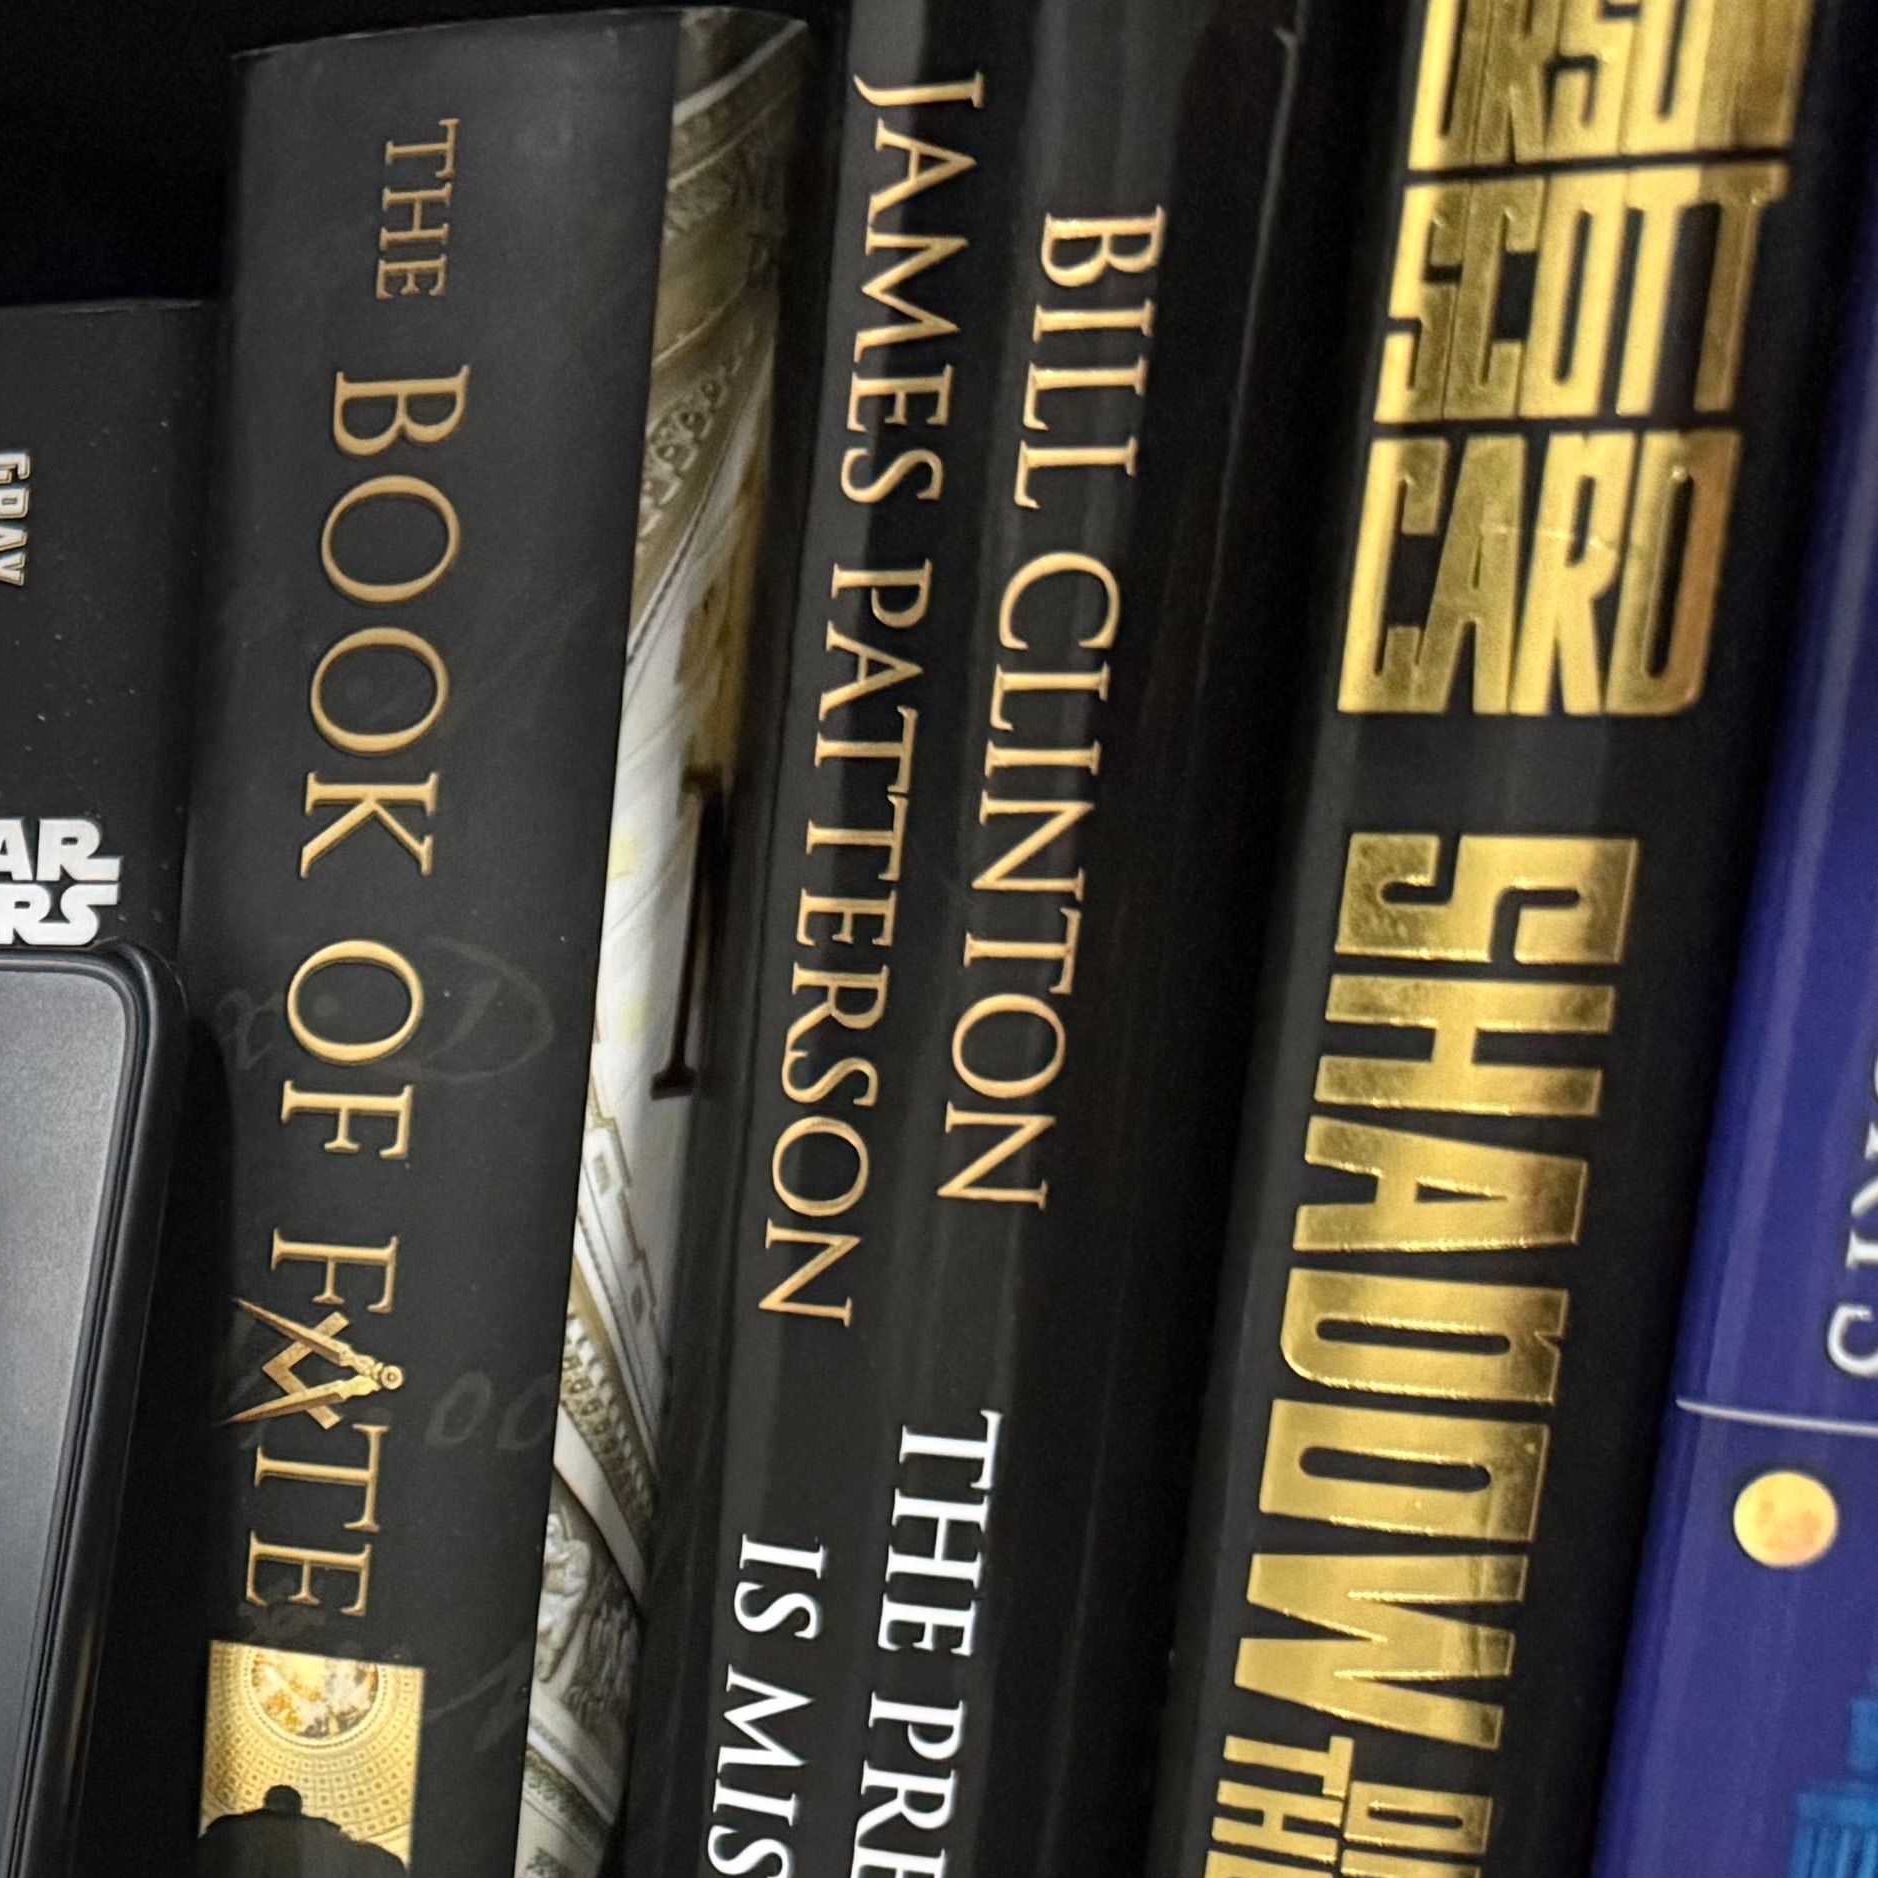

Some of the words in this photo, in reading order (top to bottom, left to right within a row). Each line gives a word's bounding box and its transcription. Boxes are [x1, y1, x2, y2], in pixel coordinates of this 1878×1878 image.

[376, 118, 459, 300] THE
[840, 71, 985, 506] JAMES
[1373, 162, 1791, 424] SCOTT
[1013, 204, 1166, 511] BILL
[299, 364, 471, 880] BOOK
[1336, 429, 1742, 715] CARD
[757, 558, 935, 1327] PATTERSON
[937, 550, 1122, 1210] CLINTON
[281, 939, 424, 1159] OF
[1233, 830, 1640, 1750] SHADOW
[732, 1531, 828, 1643] IS
[875, 1408, 1002, 1660] THE
